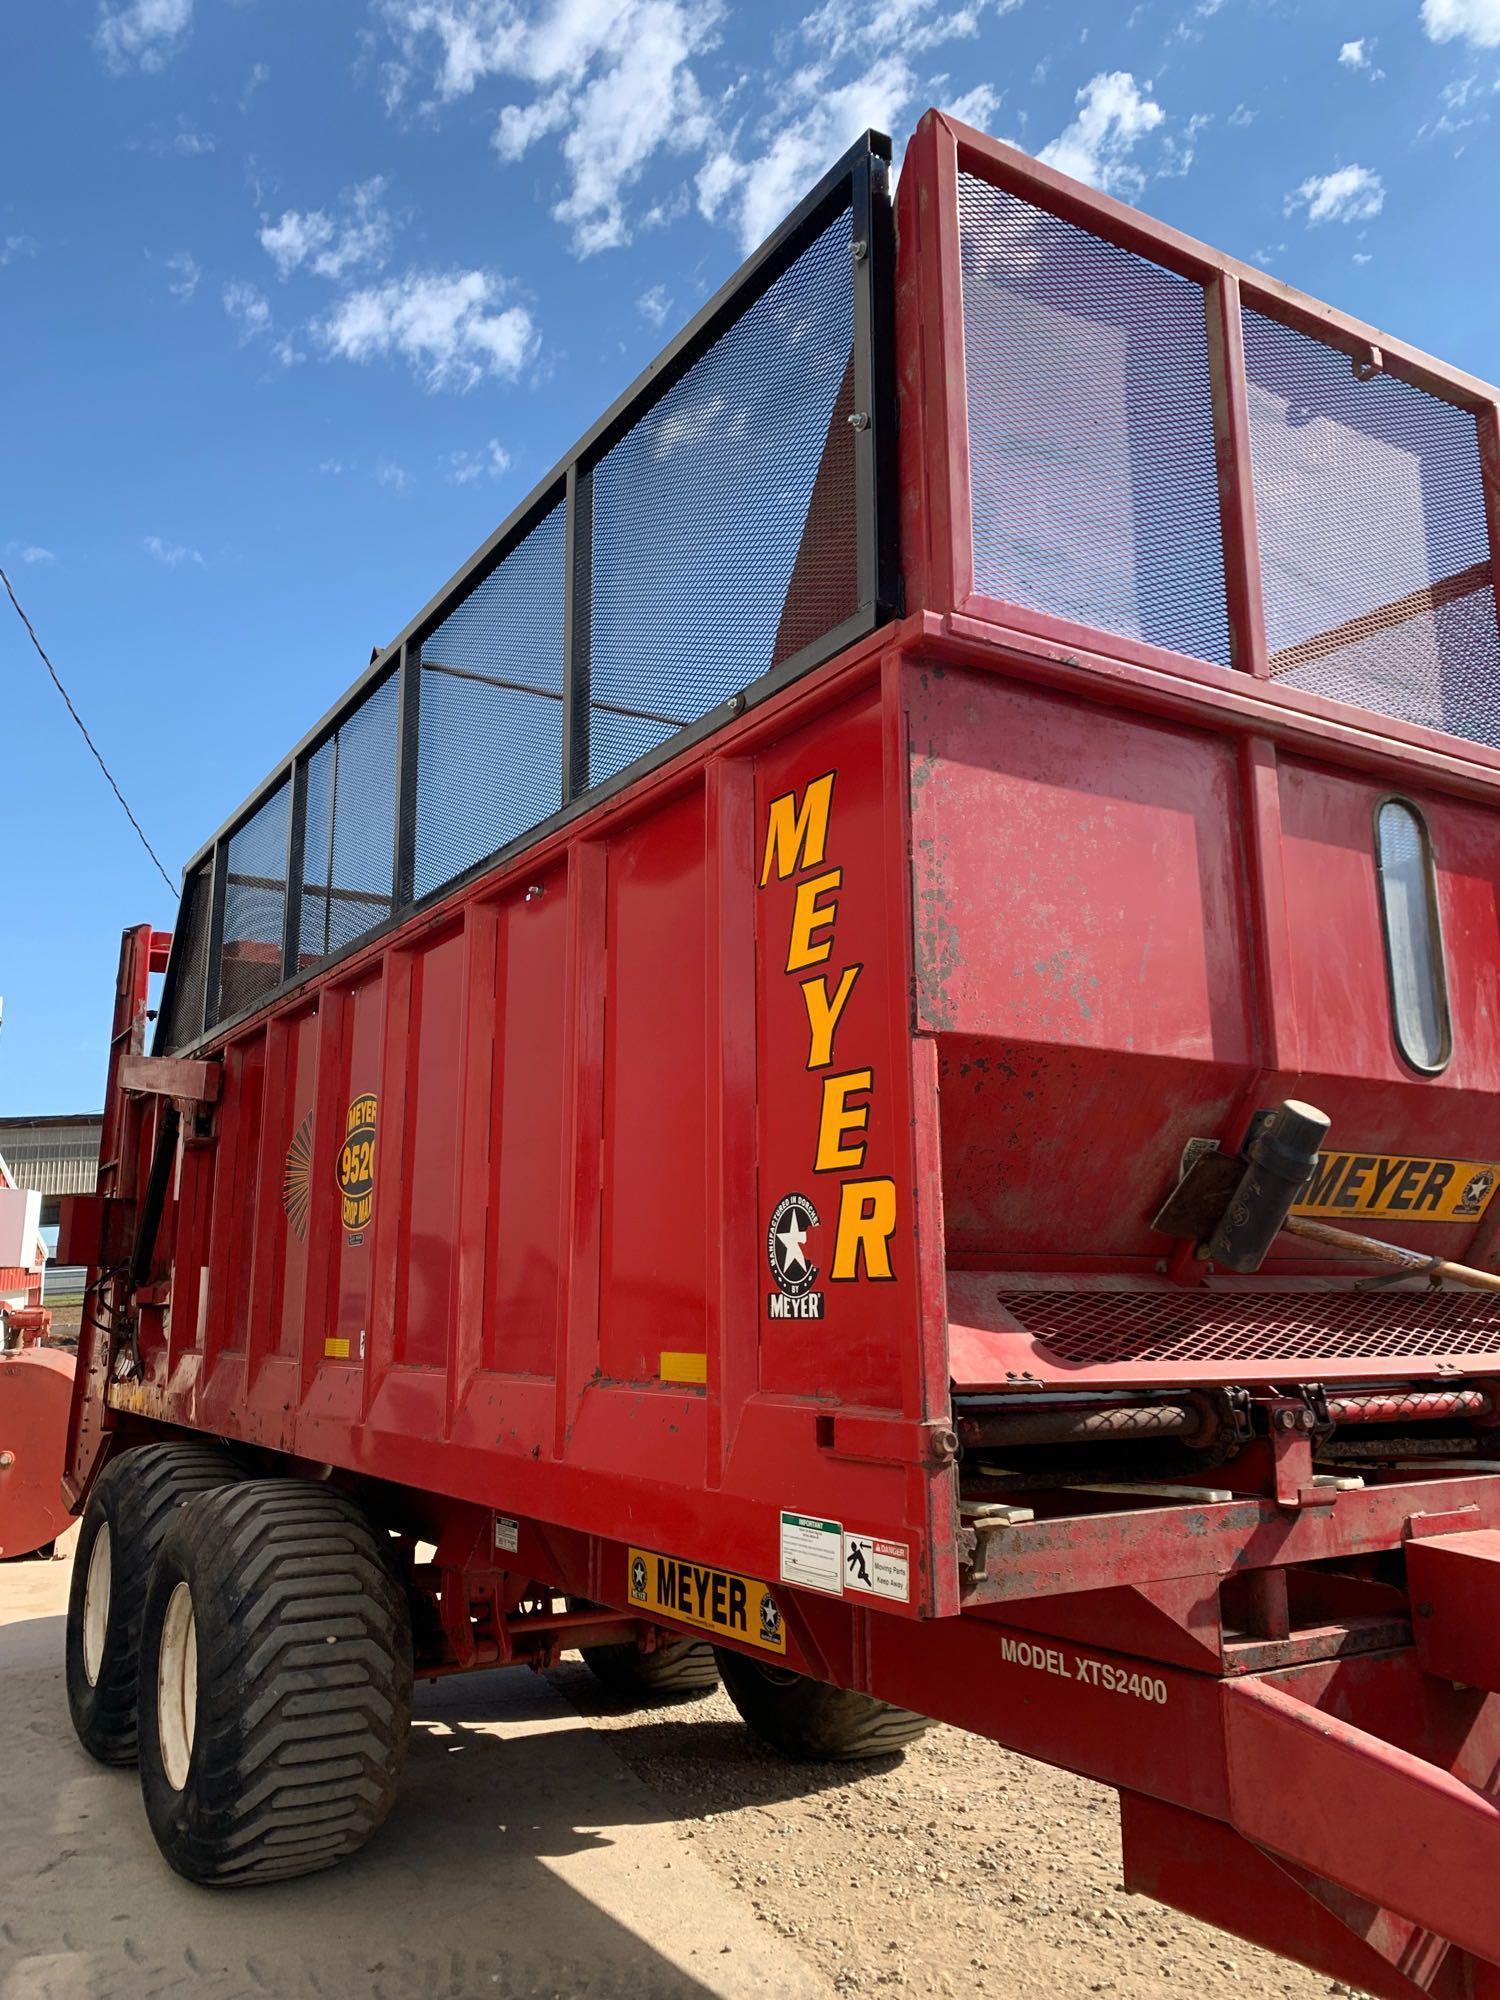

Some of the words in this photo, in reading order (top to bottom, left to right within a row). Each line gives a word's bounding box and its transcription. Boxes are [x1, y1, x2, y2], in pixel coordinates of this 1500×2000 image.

[758, 767, 898, 1282] MEYER
[348, 1101, 377, 1131] MEYER
[1294, 1154, 1456, 1211] MEYER
[768, 1198, 790, 1267] MANUFACTURED
[790, 1195, 797, 1204] IN
[791, 1285, 799, 1293] BY
[770, 1293, 819, 1318] MEYER
[880, 1544, 905, 1557] DANGER
[874, 1562, 892, 1574] Moving
[893, 1566, 906, 1577] Parts
[877, 1576, 890, 1586] Keep
[891, 1579, 904, 1590] Away
[657, 1557, 747, 1632] MEYER
[1001, 1637, 1071, 1678] MODEL
[1075, 1656, 1168, 1705] XTS2400
